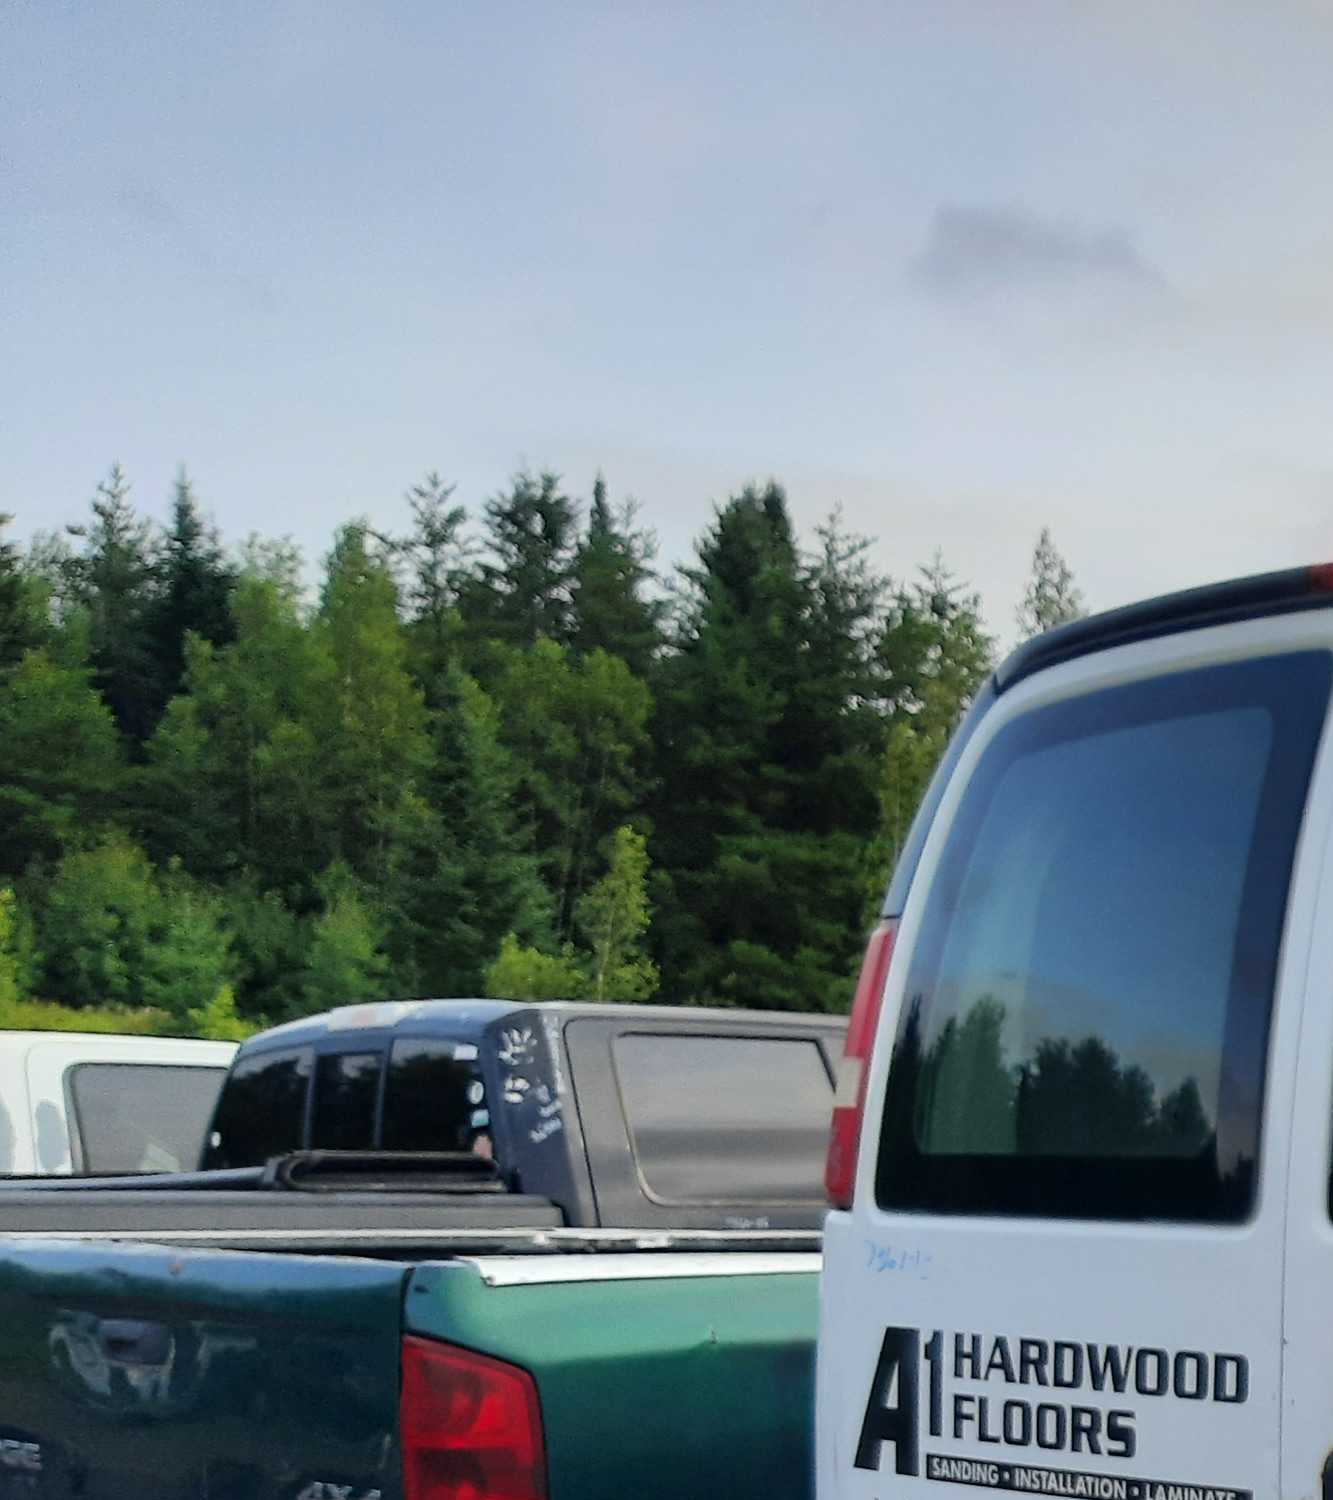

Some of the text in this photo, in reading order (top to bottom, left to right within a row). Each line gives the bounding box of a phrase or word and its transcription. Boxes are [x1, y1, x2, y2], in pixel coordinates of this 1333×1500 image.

[853, 1326, 944, 1476] A1
[953, 1332, 1250, 1404] HARDWOOD
[952, 1393, 1137, 1458] FLOORS
[931, 1456, 1000, 1485] SANDING
[1013, 1466, 1128, 1500] INSTALLATION
